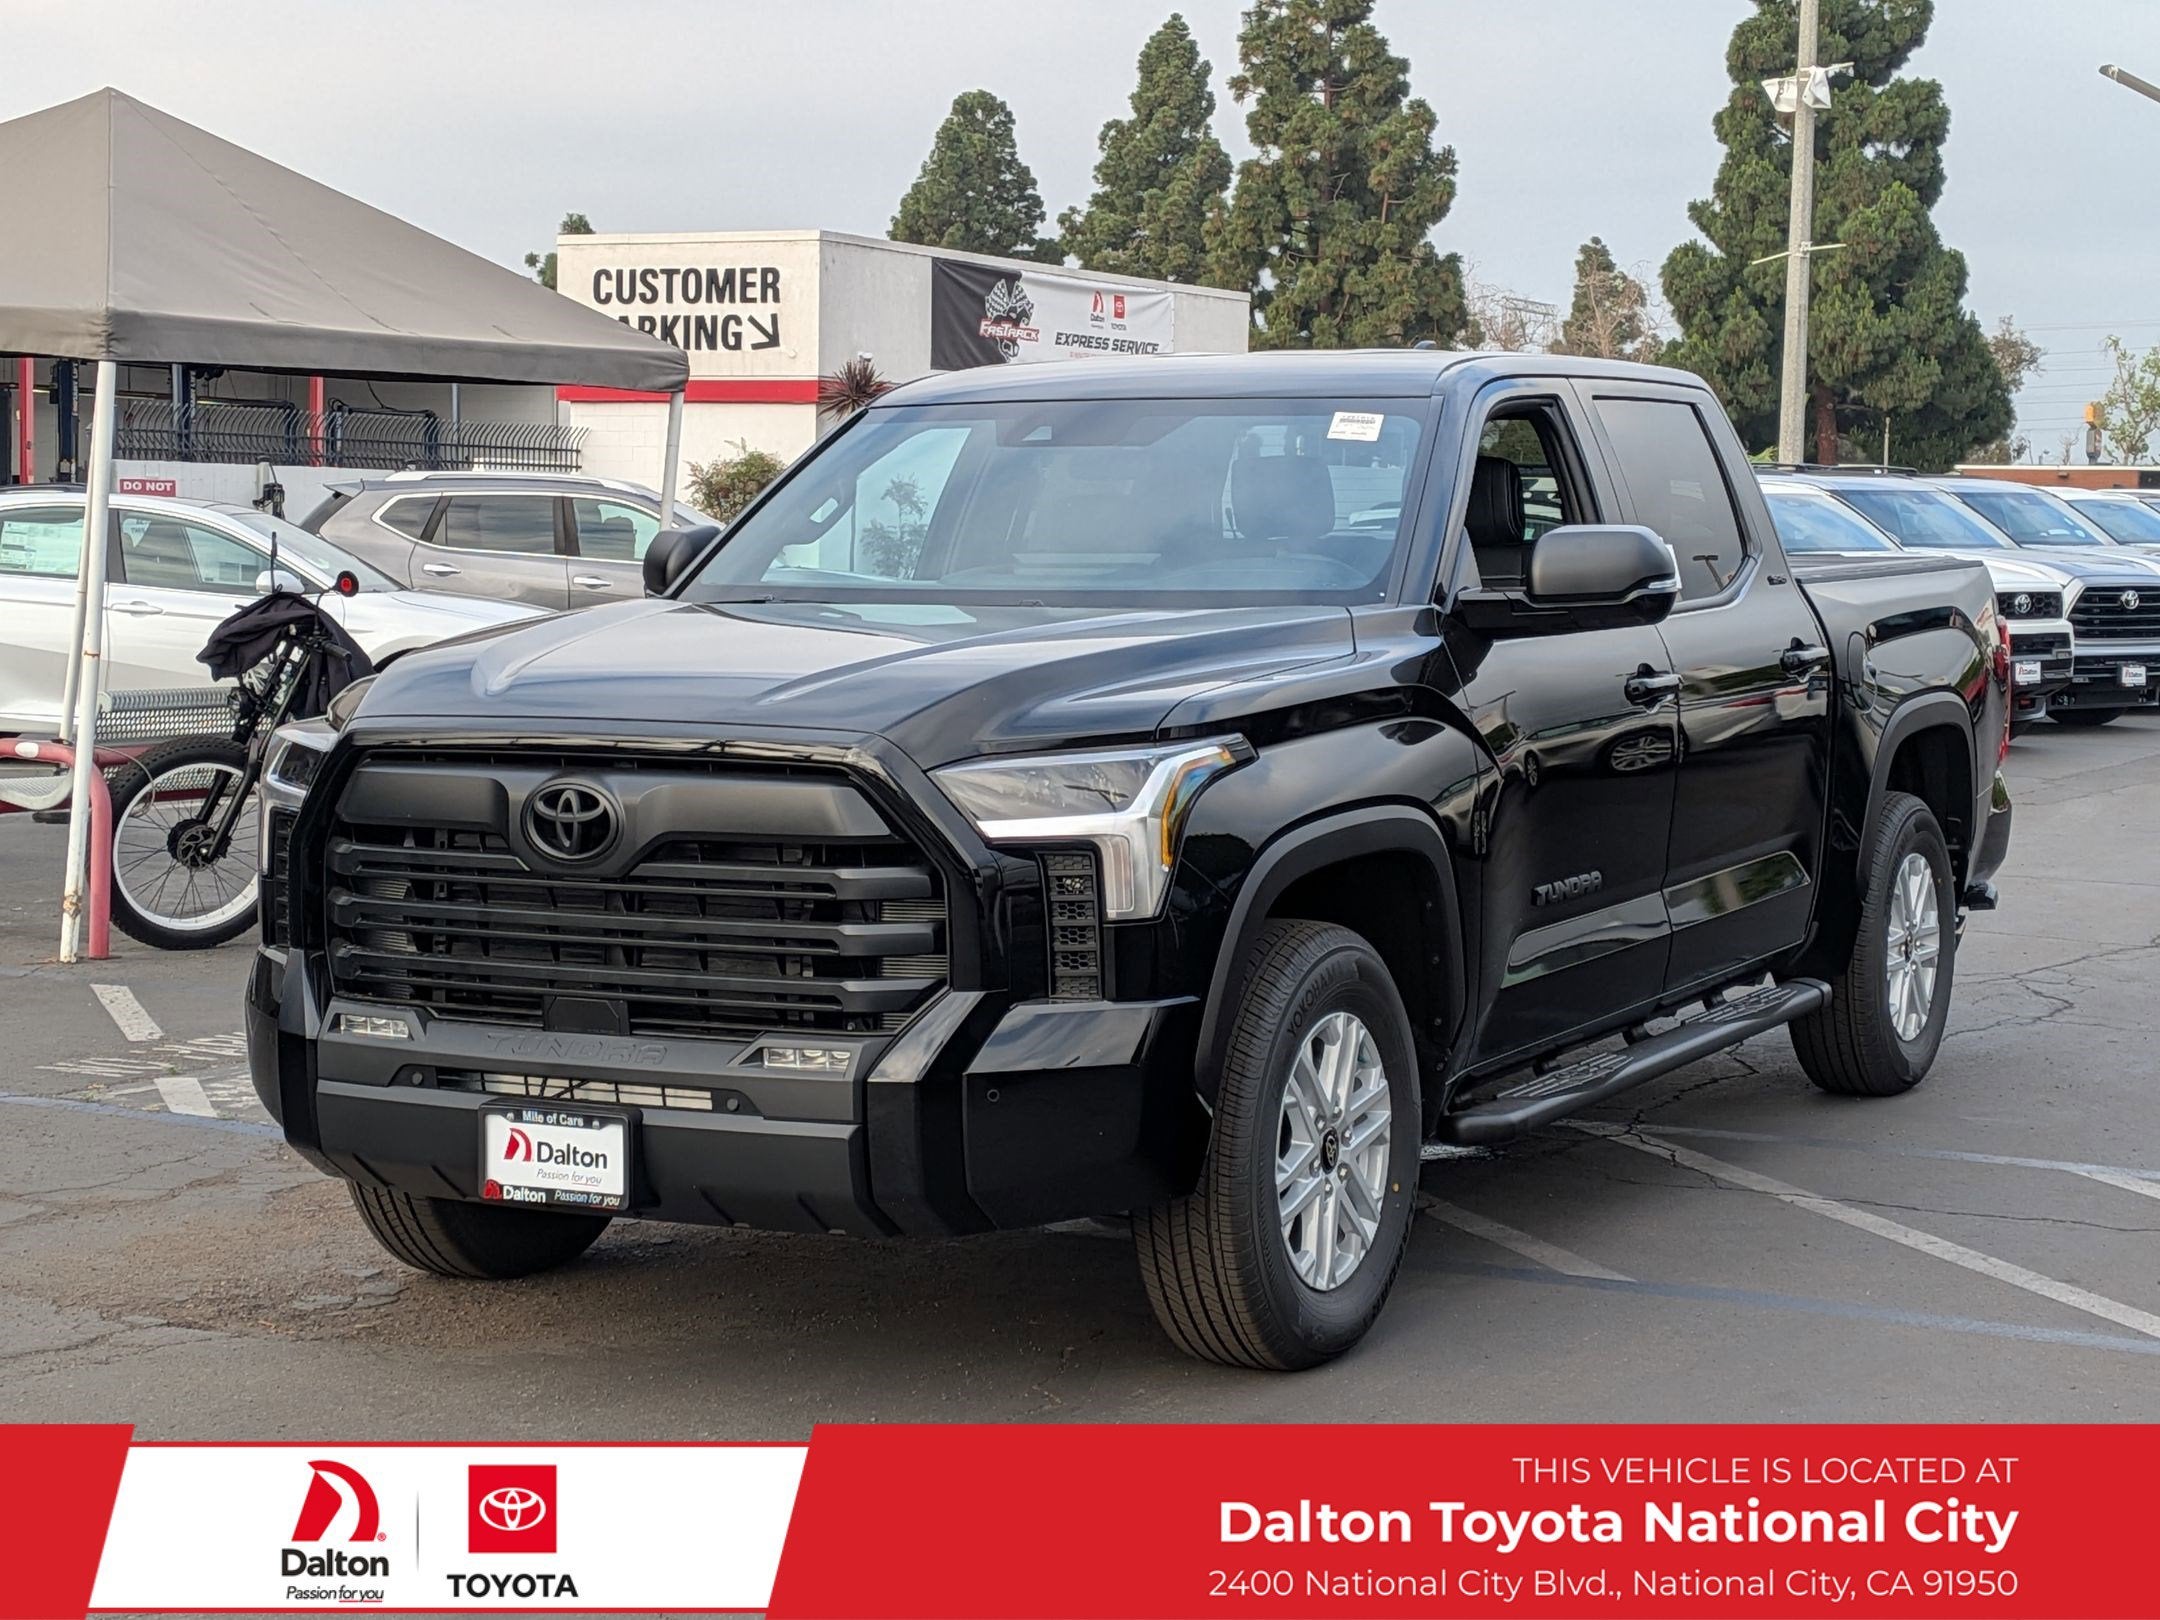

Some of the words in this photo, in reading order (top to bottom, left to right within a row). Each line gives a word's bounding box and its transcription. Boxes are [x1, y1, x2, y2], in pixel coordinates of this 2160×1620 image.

[593, 267, 781, 305] CUSTOMER
[617, 314, 743, 350] RKING
[1055, 331, 1110, 350] EXPRESS
[1111, 338, 1159, 355] SERVICE
[123, 481, 142, 491] DO
[145, 482, 173, 491] NOT
[1534, 871, 1602, 906] TUNDRA
[522, 1110, 544, 1123] Mile
[546, 1113, 557, 1124] of
[559, 1115, 584, 1127] Cars
[537, 1141, 608, 1169] Dalton
[536, 1168, 569, 1181] Passion
[571, 1171, 585, 1183] for
[585, 1175, 603, 1184] you
[503, 1186, 546, 1203] Dalton
[554, 1190, 588, 1203] Passion
[588, 1193, 602, 1204] for
[603, 1196, 620, 1207] you
